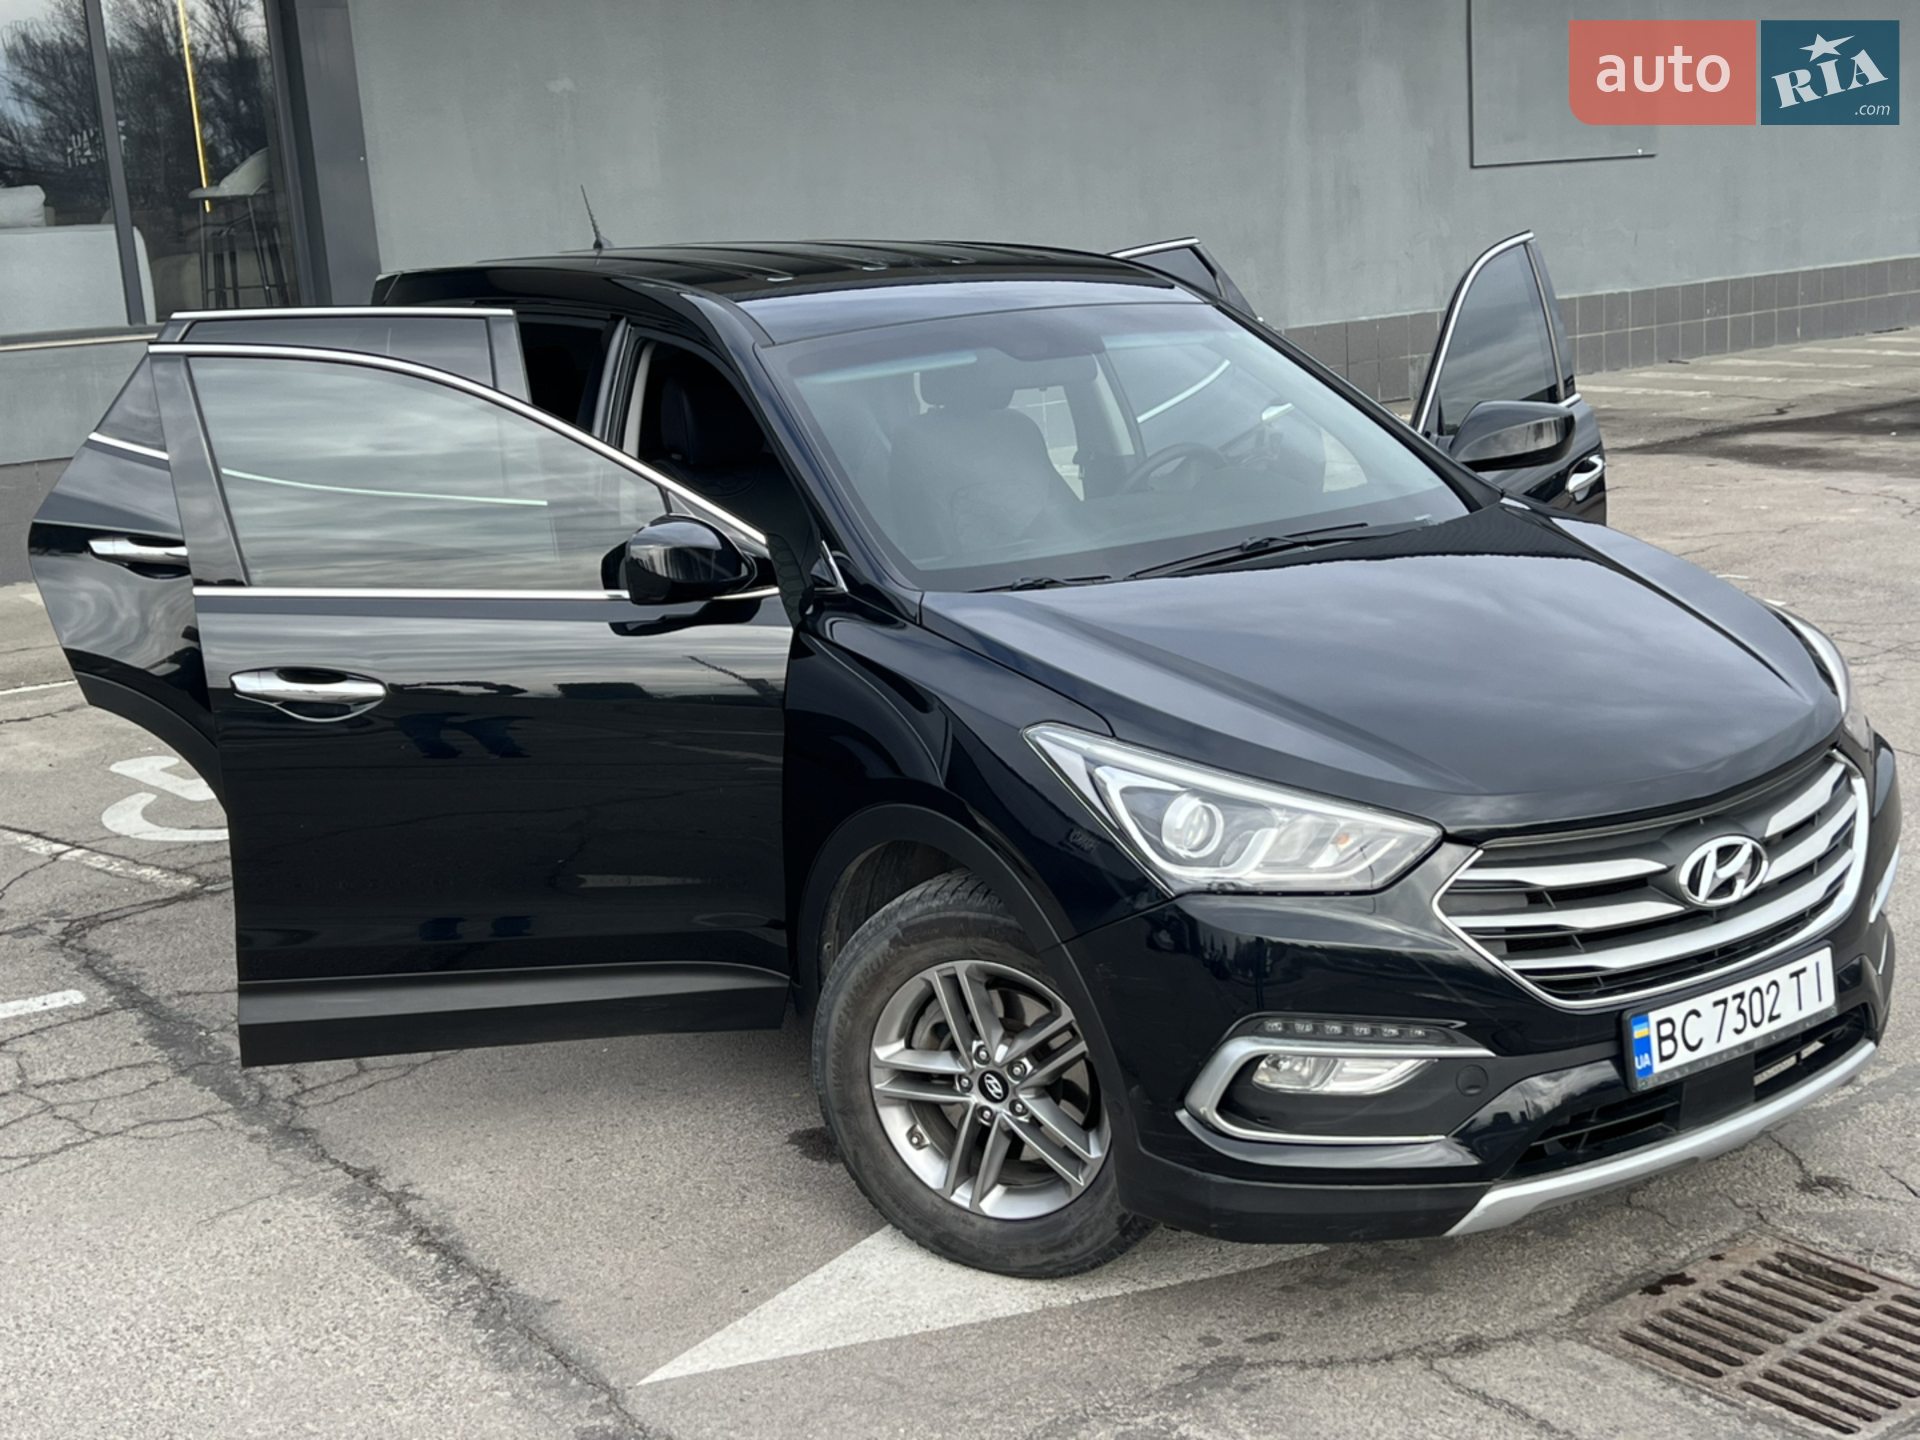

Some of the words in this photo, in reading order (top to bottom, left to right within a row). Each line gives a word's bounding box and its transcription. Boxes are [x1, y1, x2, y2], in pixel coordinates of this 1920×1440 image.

[1656, 1008, 1704, 1063] BC
[1712, 979, 1781, 1044] 7302
[1635, 1053, 1651, 1070] UA
